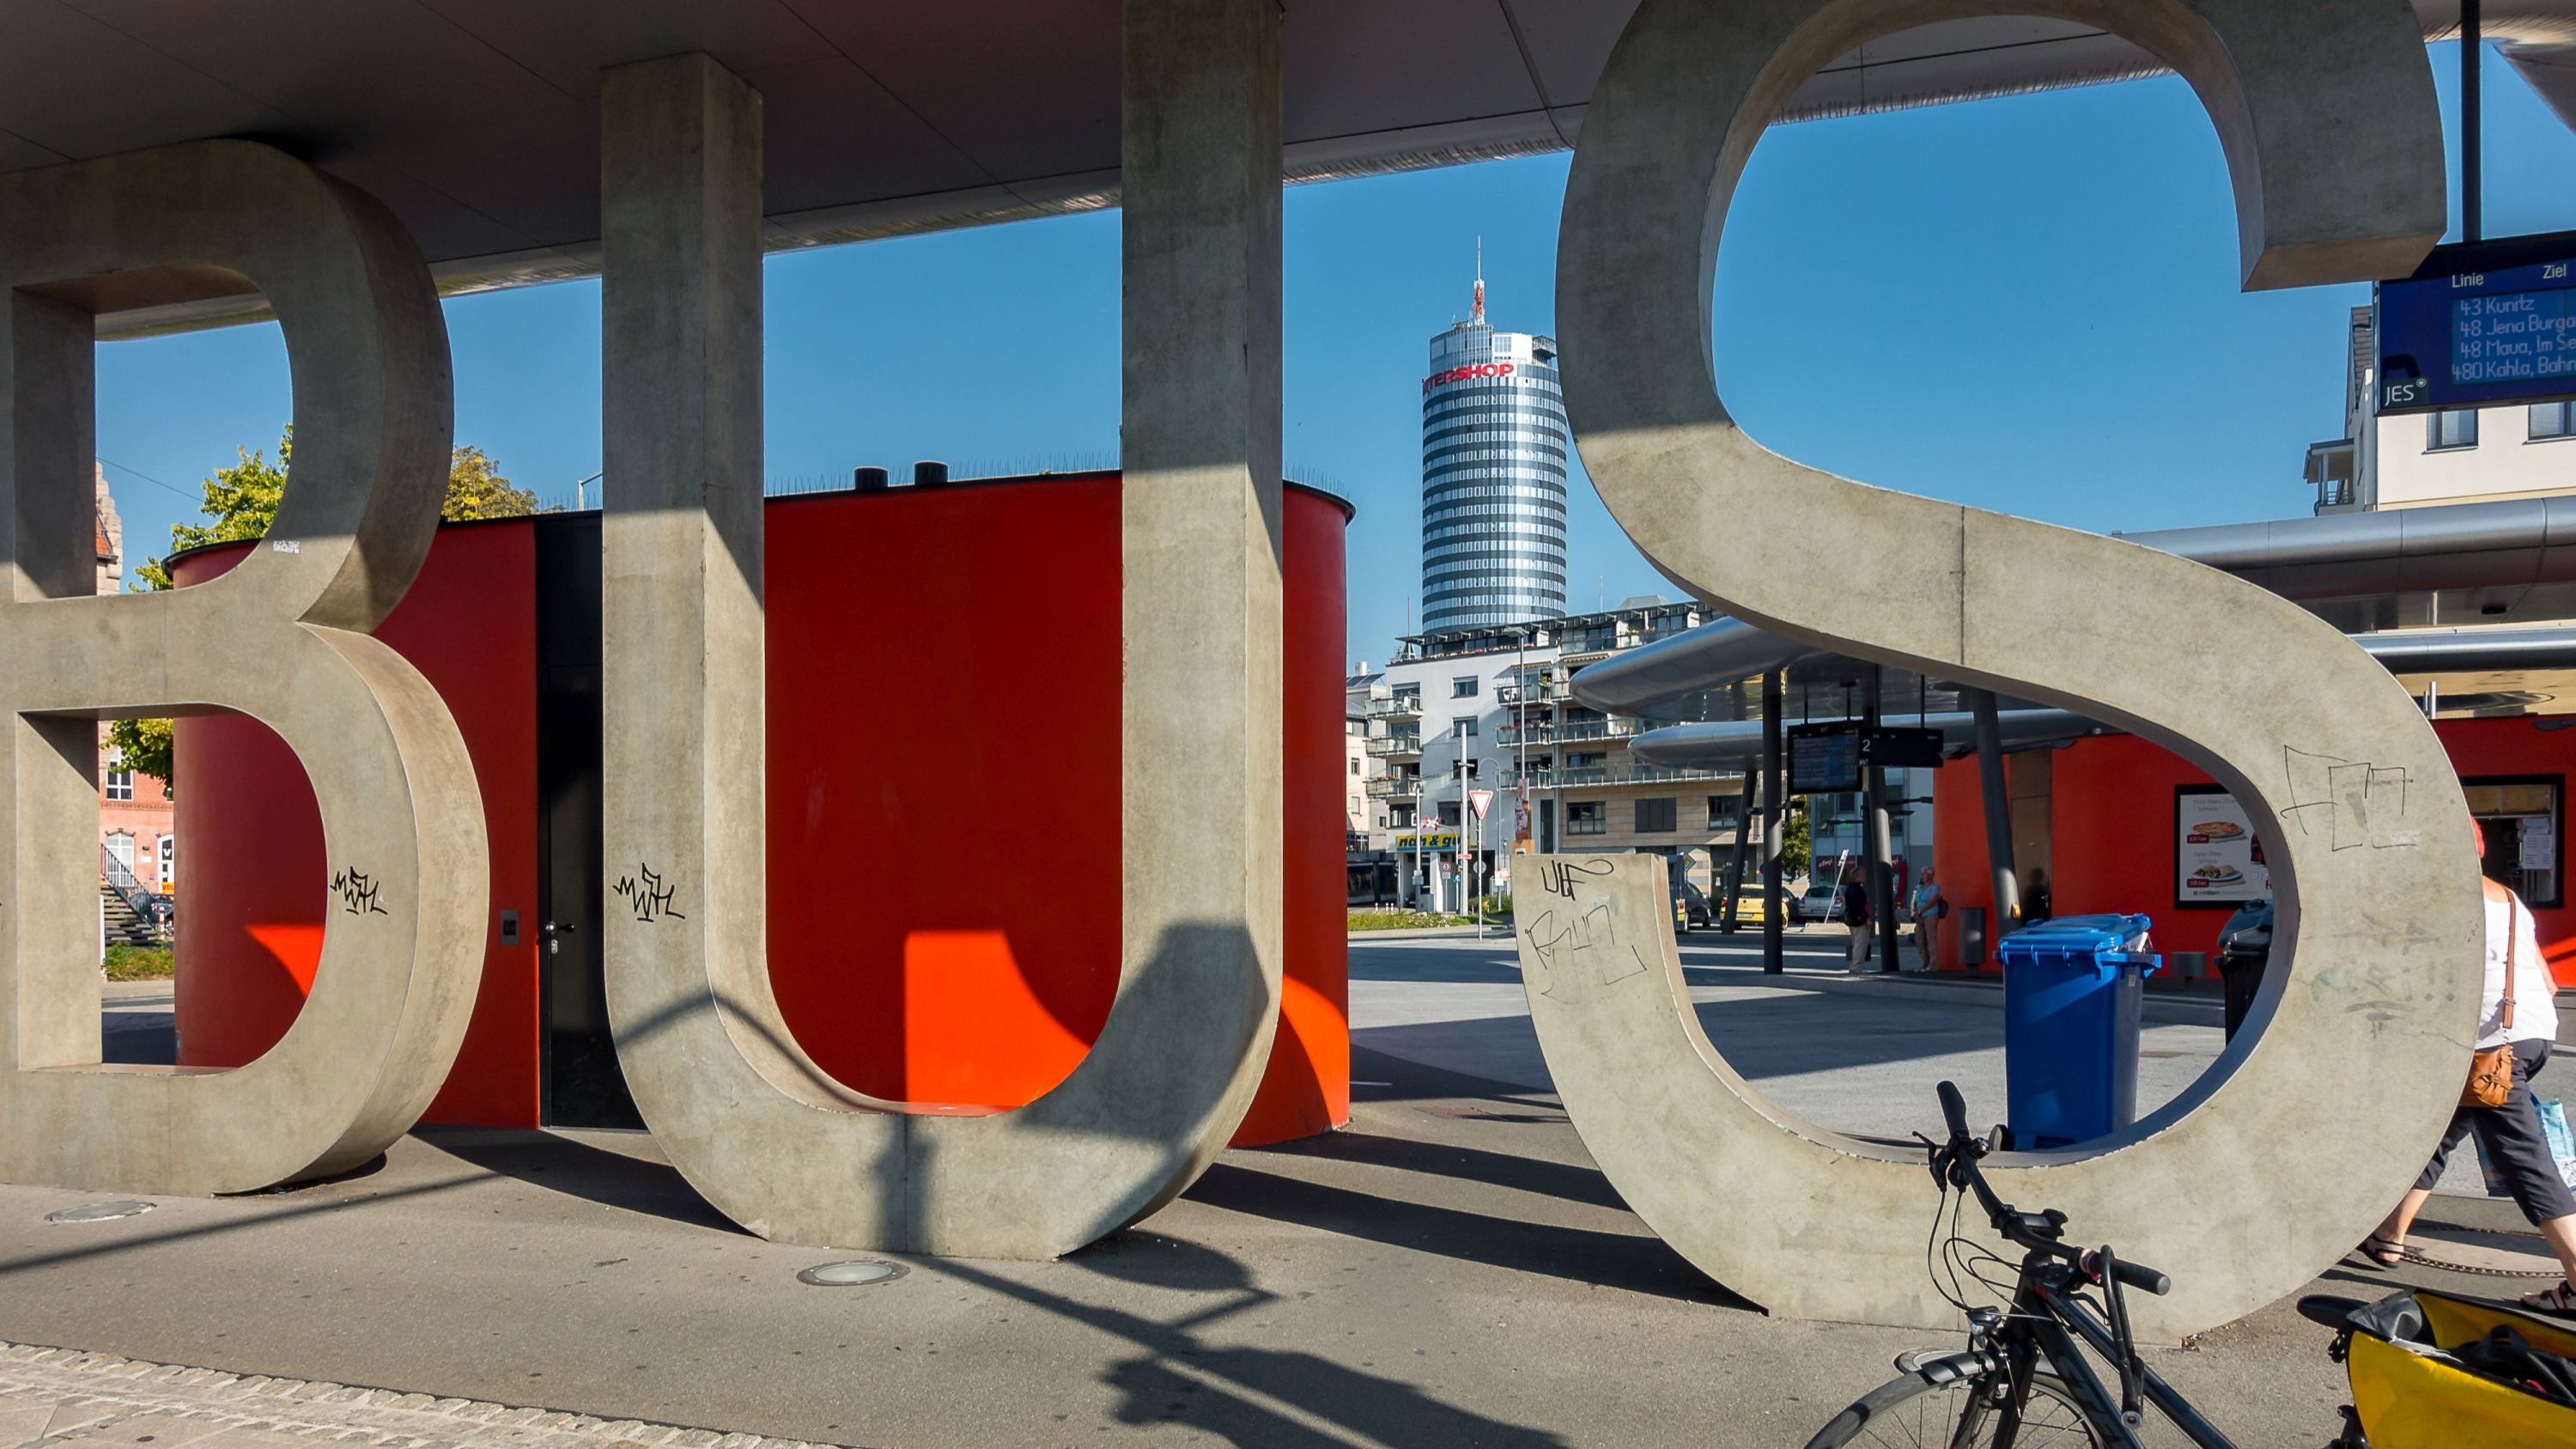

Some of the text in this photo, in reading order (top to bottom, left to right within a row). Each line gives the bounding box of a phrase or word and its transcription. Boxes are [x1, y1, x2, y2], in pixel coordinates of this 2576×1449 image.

[2451, 264, 2567, 288] Linie Ziel
[2460, 294, 2536, 316] 43 Kunitz
[2460, 319, 2482, 337] 48
[2486, 317, 2525, 335] Jena
[2460, 340, 2482, 358] 48
[2537, 335, 2554, 352] Im
[2451, 361, 2483, 381] 480
[2486, 358, 2535, 378] Kahla,
[2385, 384, 2415, 406] JES
[1862, 739, 1871, 752] 2
[1429, 835, 1440, 847] &
